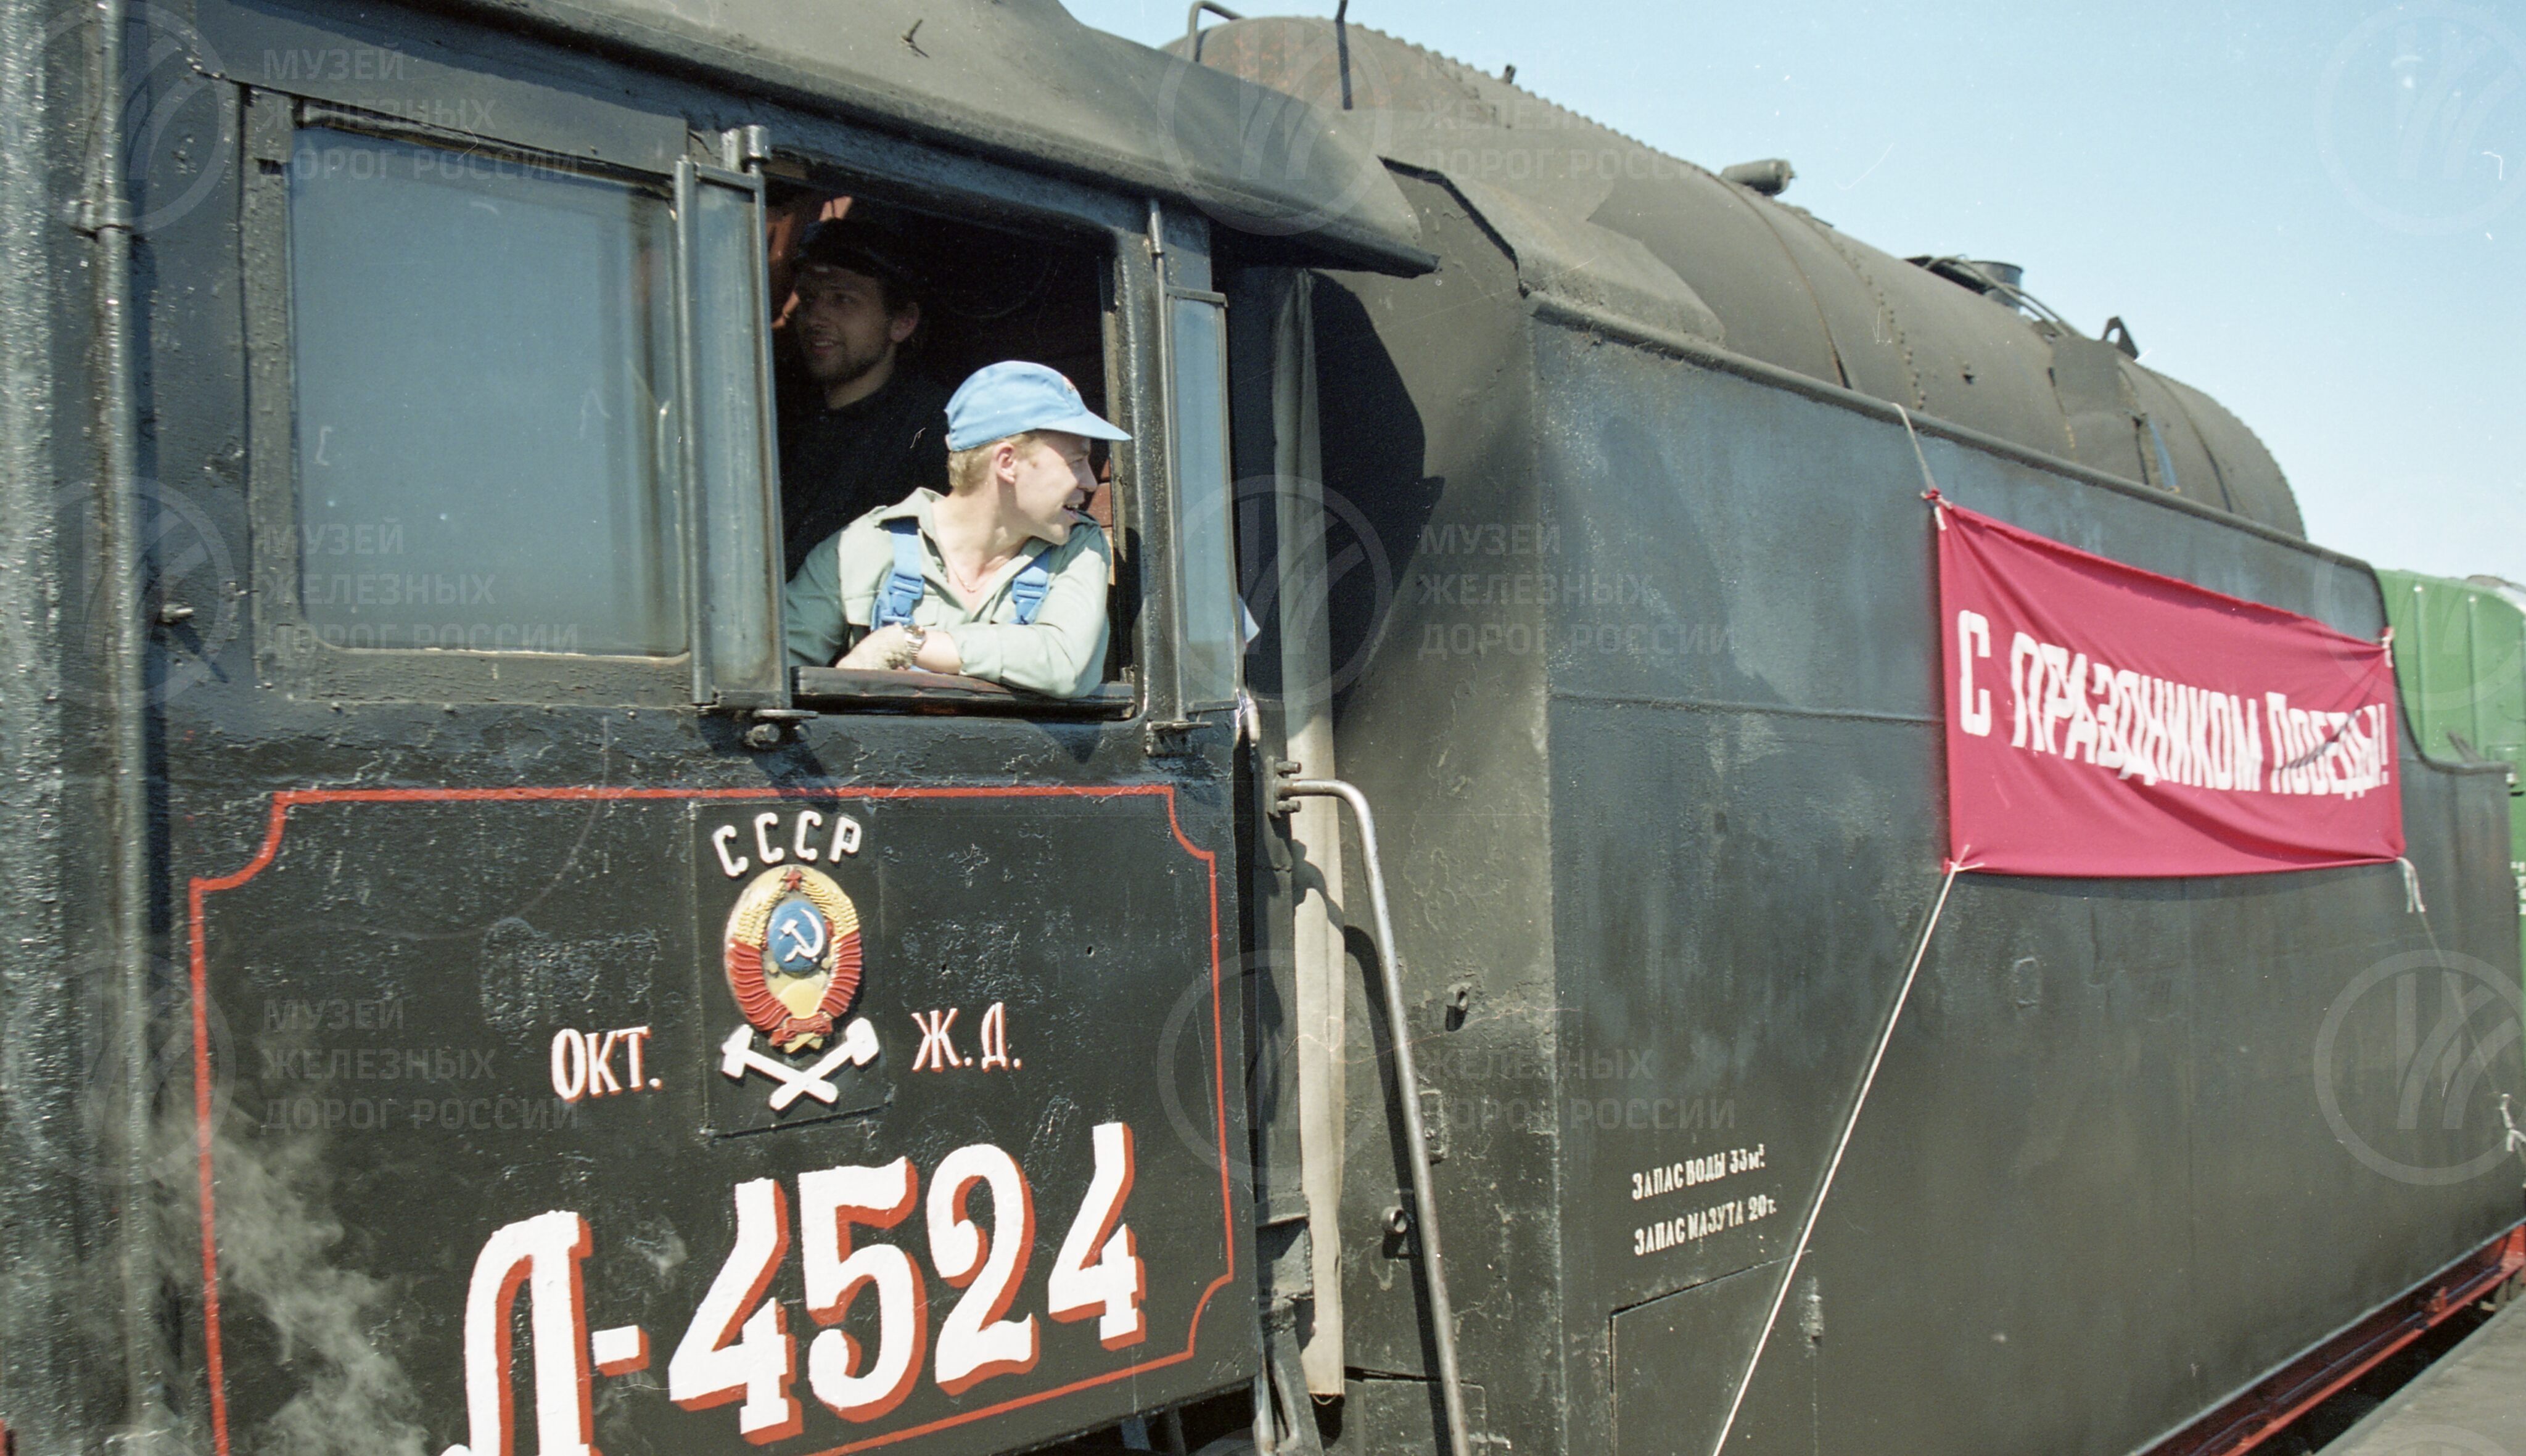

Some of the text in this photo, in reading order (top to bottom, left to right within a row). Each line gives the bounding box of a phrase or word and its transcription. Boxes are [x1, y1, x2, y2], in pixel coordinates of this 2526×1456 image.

[1958, 610, 1991, 737] С
[2010, 631, 2264, 792] ПРАЗДНИКОМ
[712, 811, 863, 878] СССР
[551, 1026, 662, 1103] ОКТ.
[1632, 1162, 1684, 1200] ЗАПАС
[1685, 1153, 1726, 1186] ВОДЫ
[1634, 1217, 1685, 1256] ЗАПАС
[1687, 1200, 1744, 1240] МАЗУТА
